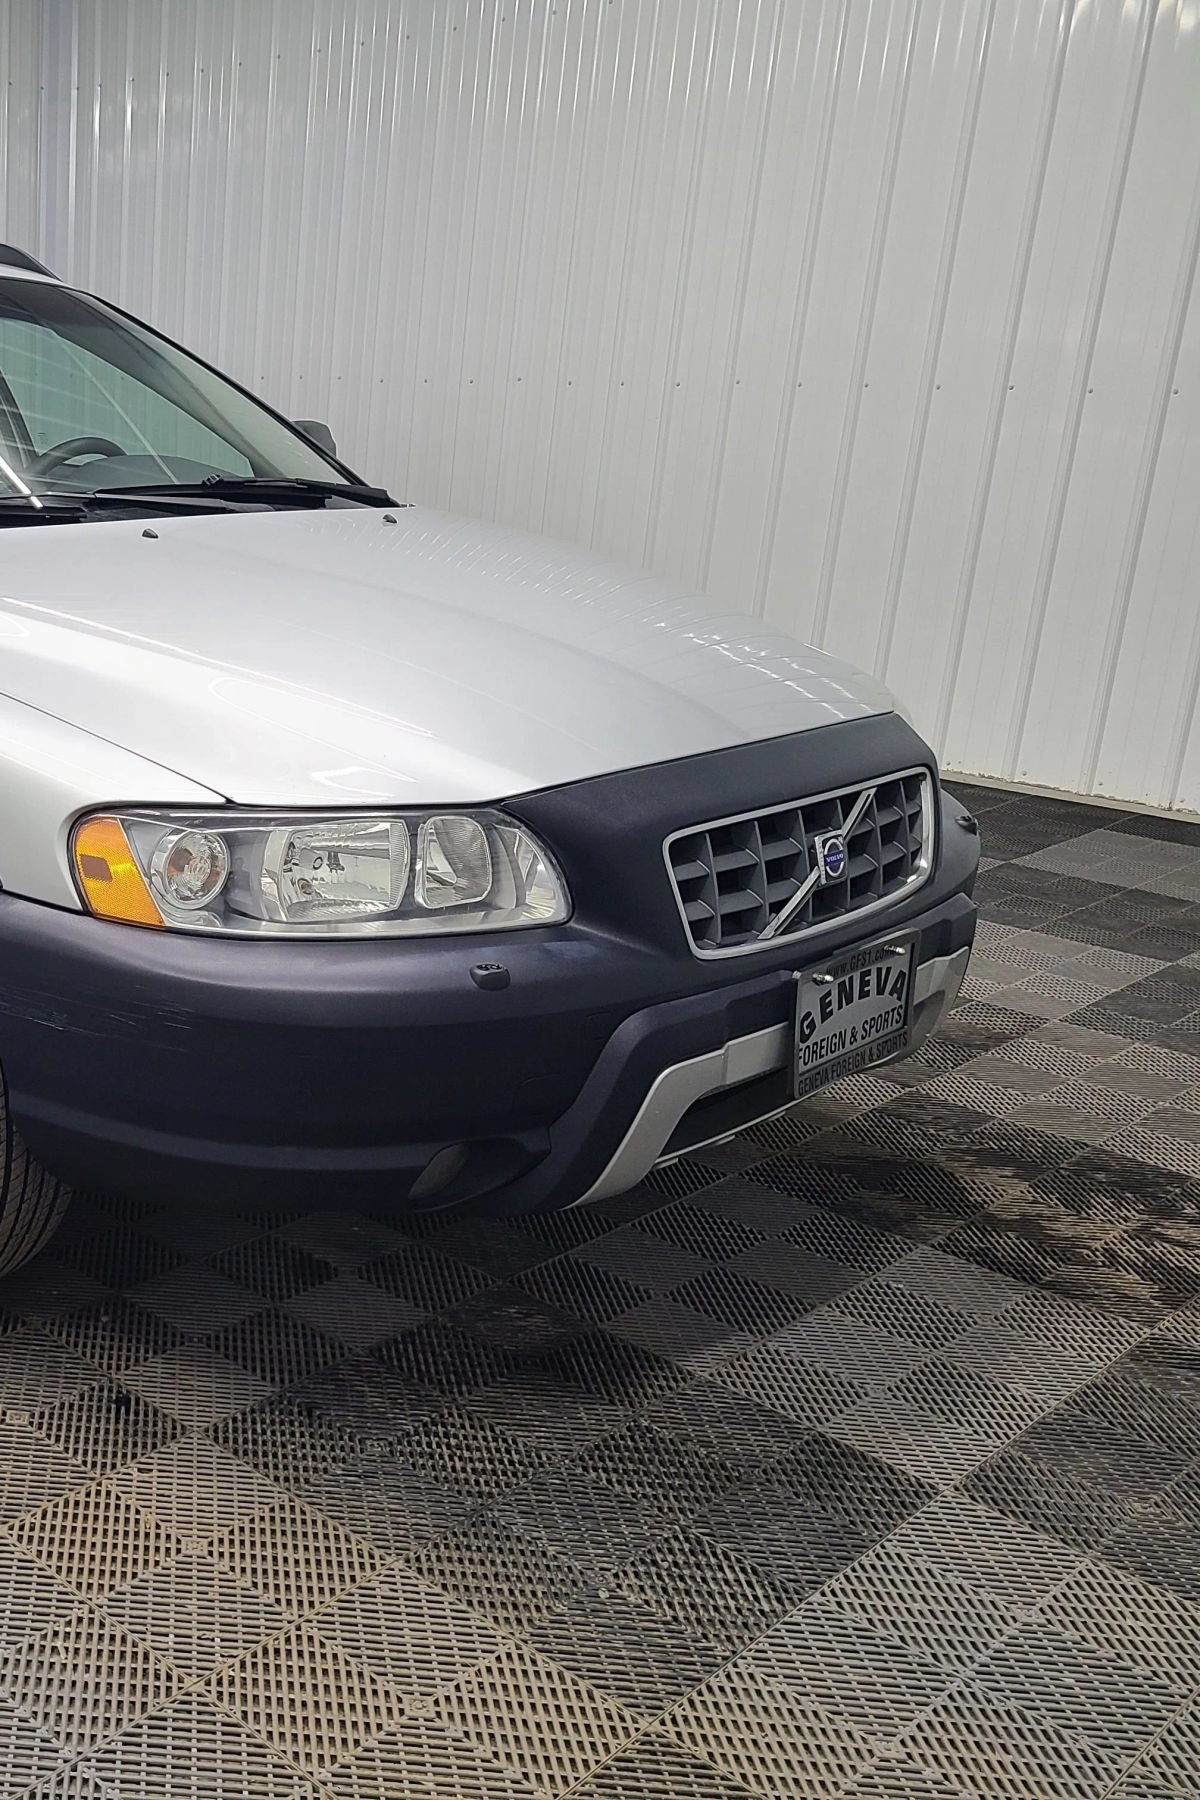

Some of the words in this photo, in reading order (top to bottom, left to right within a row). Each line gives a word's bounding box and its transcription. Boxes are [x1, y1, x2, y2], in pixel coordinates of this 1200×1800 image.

[826, 853, 844, 863] VOLVO
[799, 966, 907, 1044] GENEVA
[850, 1026, 858, 1045] &
[861, 1004, 903, 1041] SPORTS
[799, 1071, 830, 1096] GENEVA
[831, 1050, 866, 1080] FOREIGN
[867, 1046, 875, 1063] &
[876, 1031, 909, 1059] SPORTS
